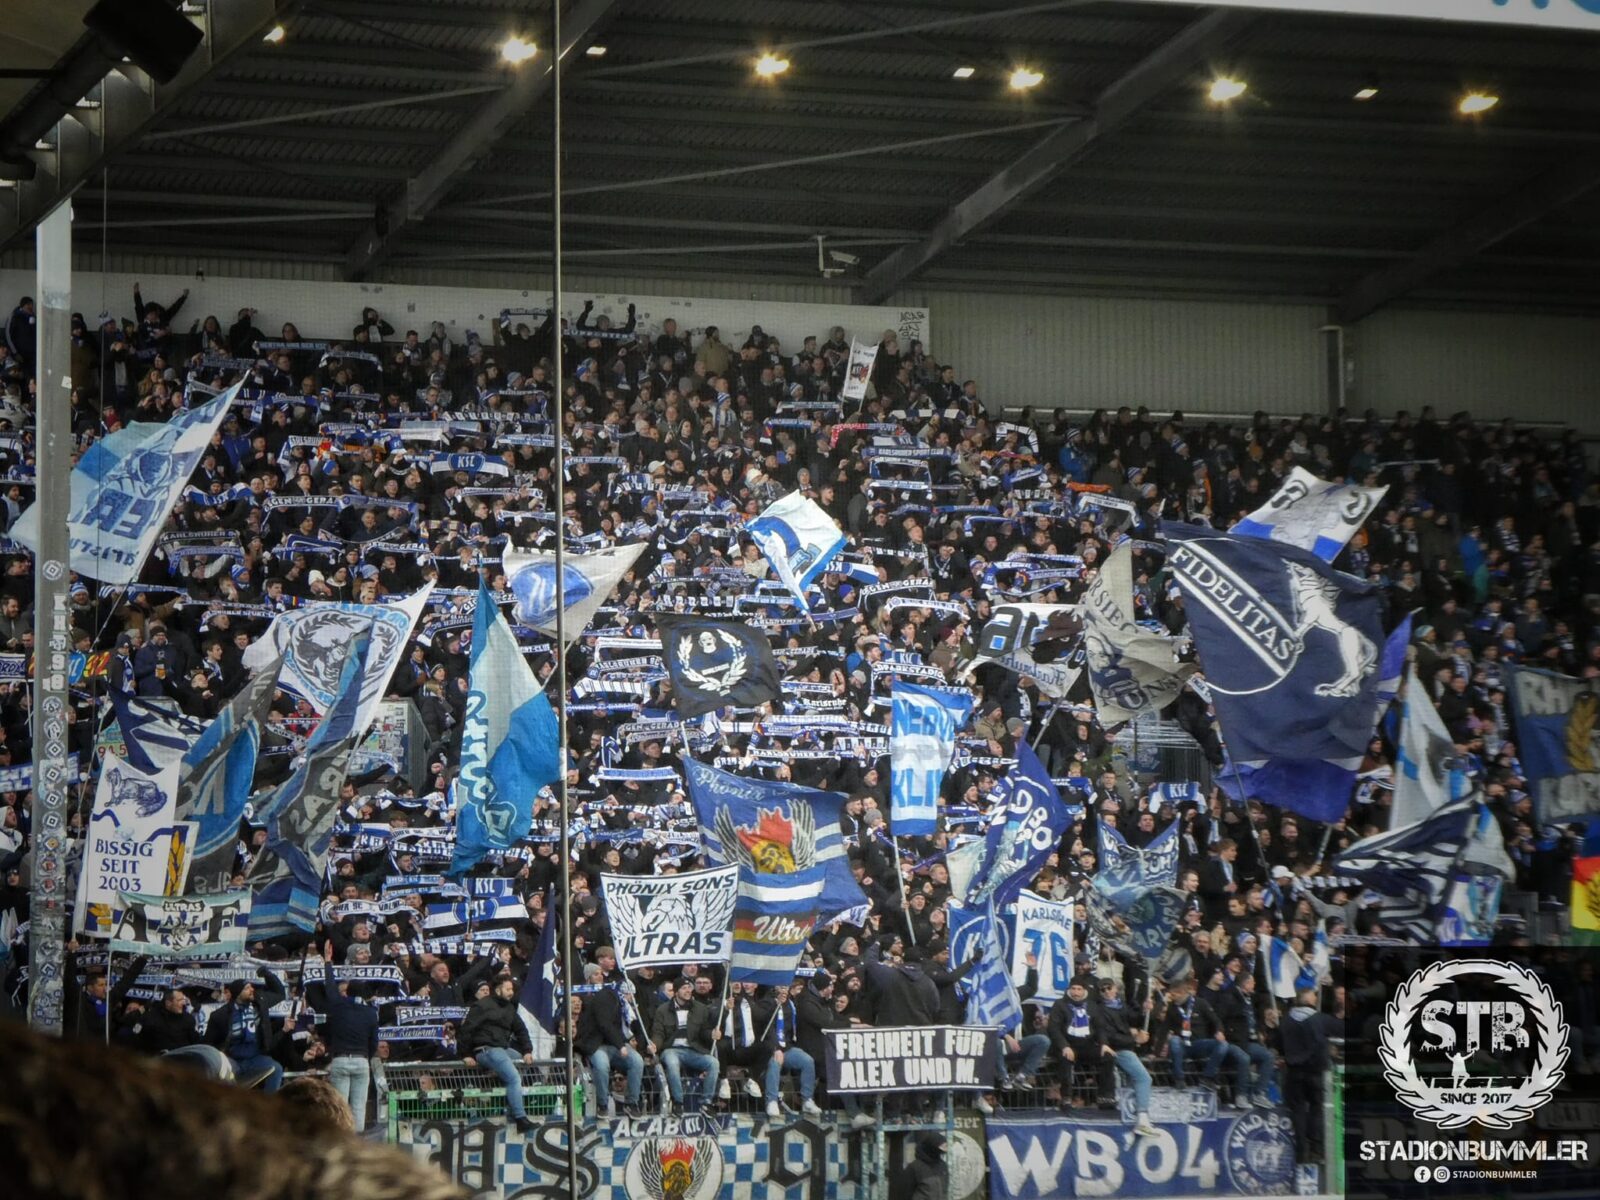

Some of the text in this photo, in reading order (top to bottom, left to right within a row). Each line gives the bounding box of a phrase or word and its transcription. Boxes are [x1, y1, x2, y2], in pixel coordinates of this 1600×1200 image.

[457, 455, 476, 468] KSC
[1169, 546, 1296, 662] FIDELITAS
[1169, 783, 1188, 798] KSC
[95, 838, 154, 858] BISSIG
[100, 858, 140, 875] SEIT
[98, 875, 143, 893] 2003
[475, 878, 495, 894] KSC
[606, 873, 737, 895] PHÖNIX SONS
[162, 900, 204, 912] ULTRAS
[1022, 927, 1071, 992] 76
[835, 1030, 985, 1060] FREIHEIT FÜR
[840, 1058, 980, 1089] ALEX UND M.
[613, 1119, 681, 1138] ACAB
